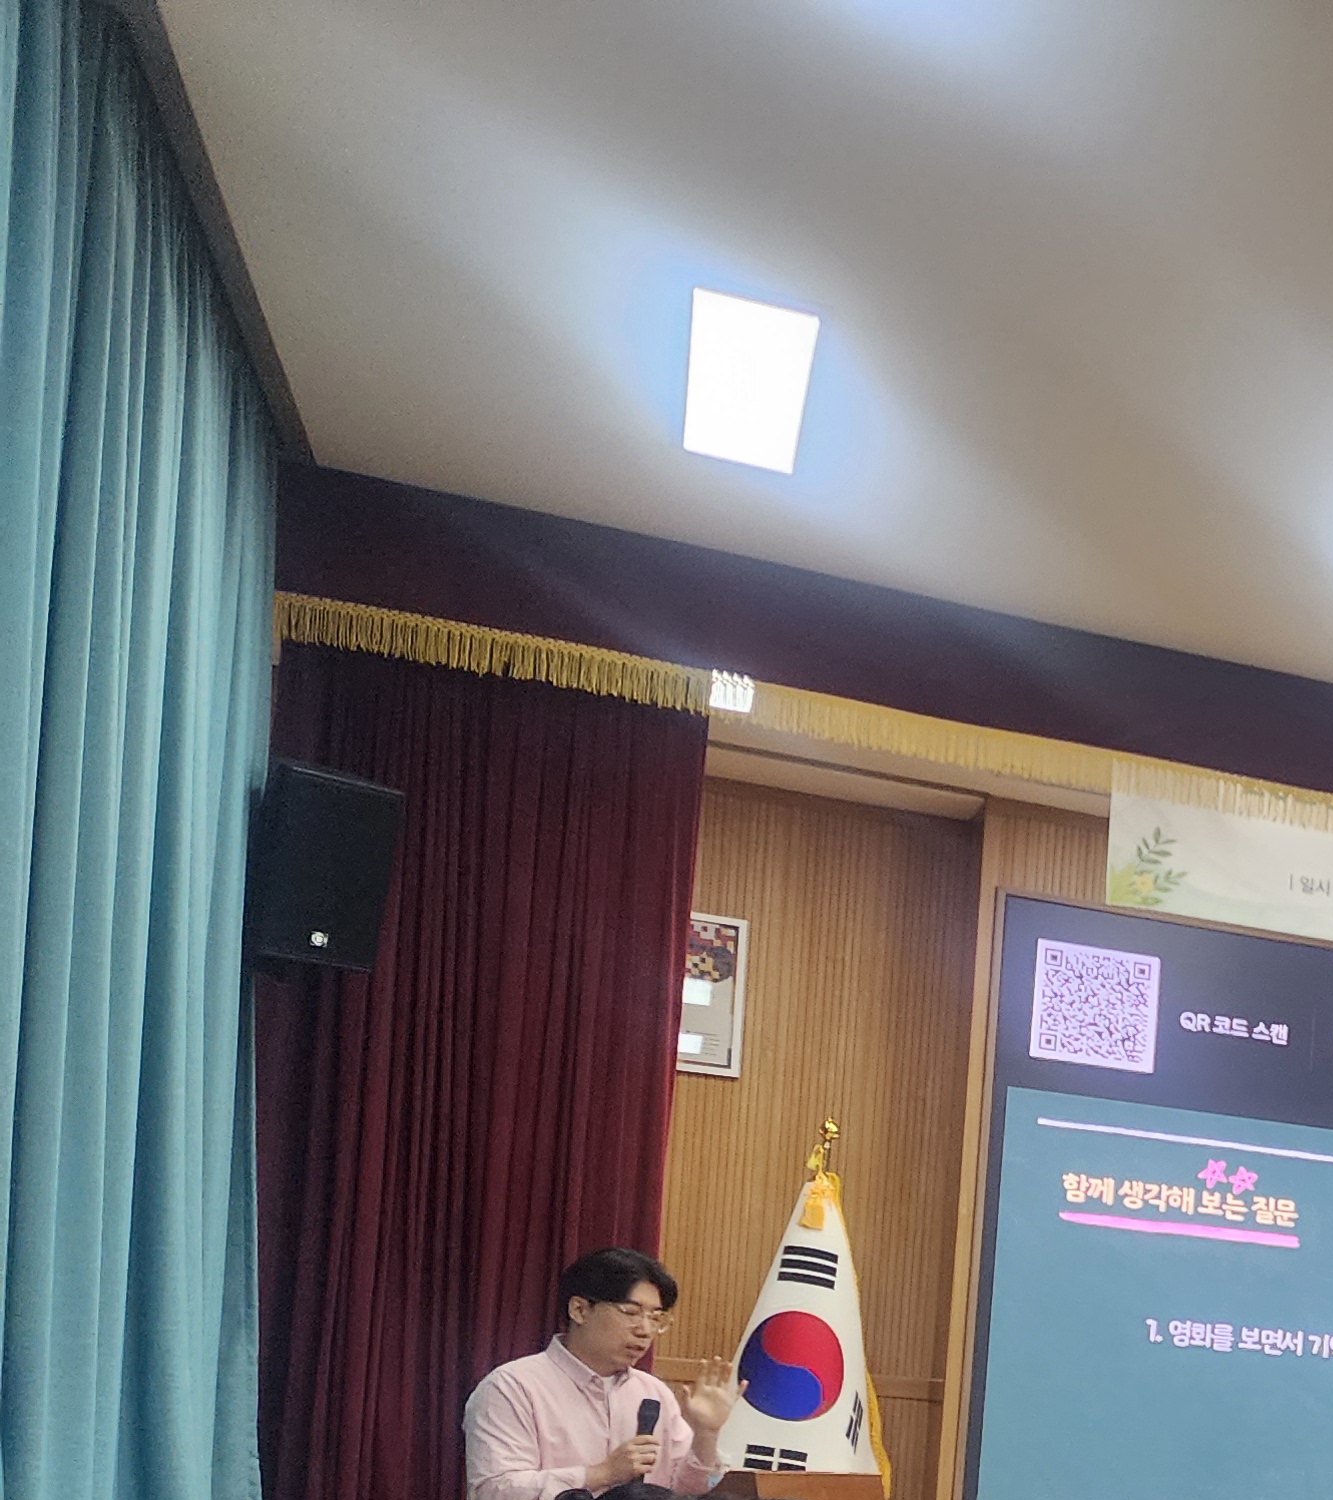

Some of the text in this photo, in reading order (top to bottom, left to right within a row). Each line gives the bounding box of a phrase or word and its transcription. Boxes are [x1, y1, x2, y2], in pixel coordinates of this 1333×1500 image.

[1300, 876, 1331, 894] 일시
[1179, 1011, 1289, 1046] QR 코드 스캔
[1062, 1172, 1299, 1228] 함께 생각해 보는 질문
[1146, 1318, 1163, 1343] 1.
[1168, 1319, 1235, 1353] 영화를
[1238, 1326, 1304, 1357] 보면서
